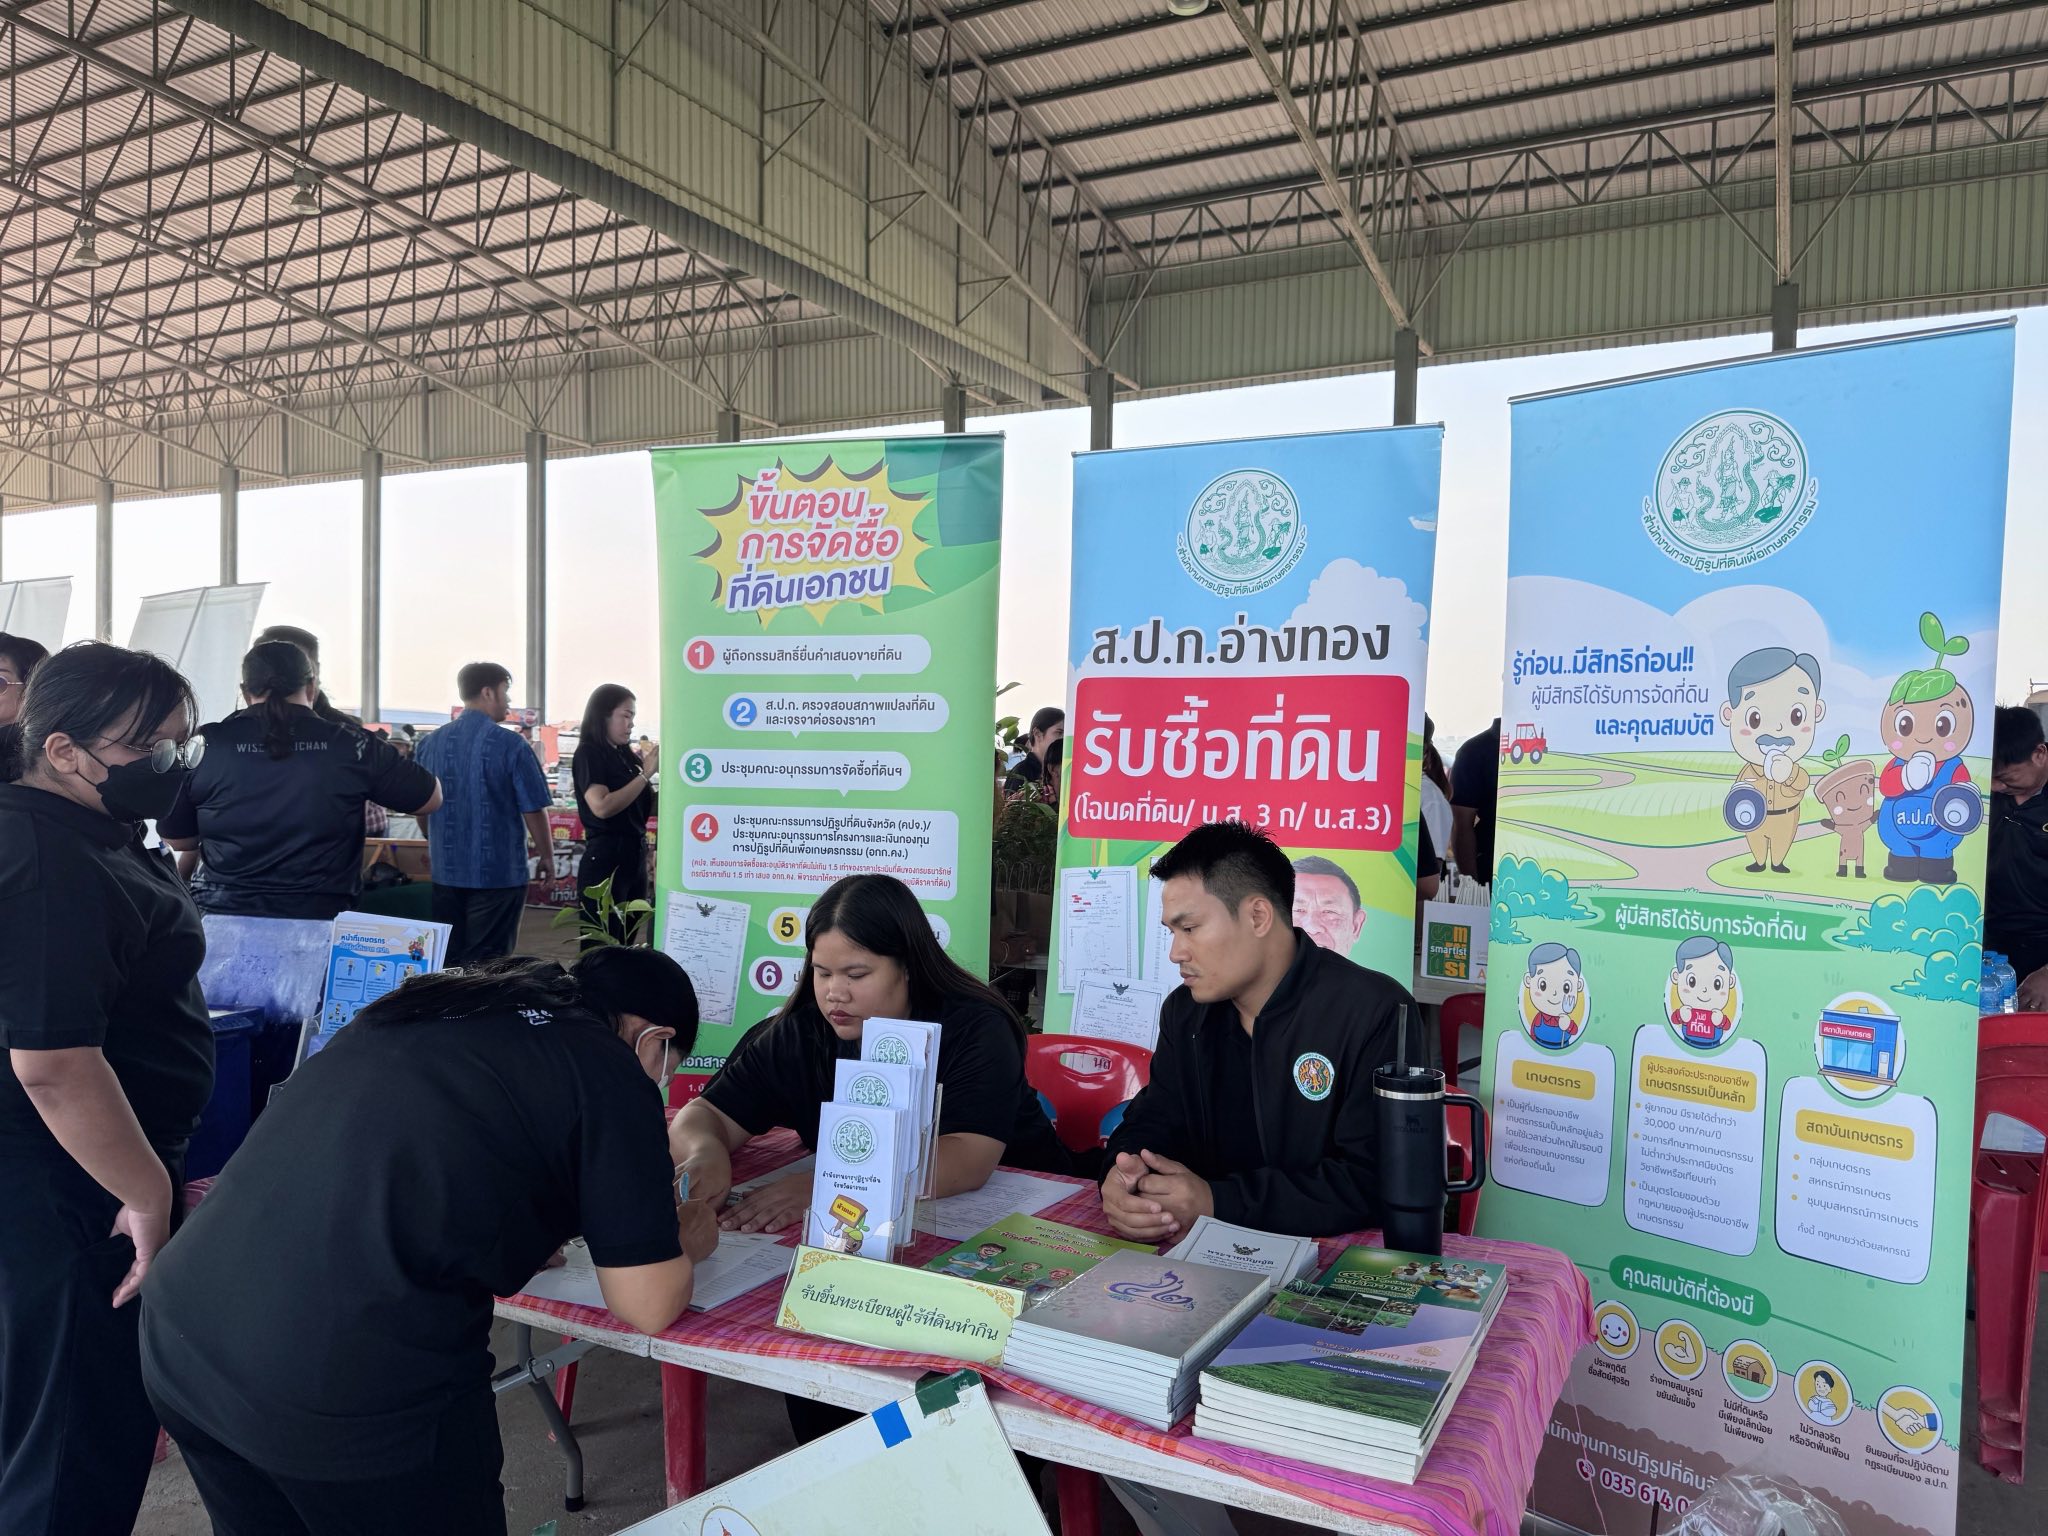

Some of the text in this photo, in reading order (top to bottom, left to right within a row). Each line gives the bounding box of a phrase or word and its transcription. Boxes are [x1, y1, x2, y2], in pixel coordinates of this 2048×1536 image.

[750, 472, 866, 521] ขั้นตอน
[740, 508, 899, 560] การจัดซื้อ
[728, 564, 889, 609] ที่ดินเอกชน
[1092, 614, 1391, 665] ส.ป.ก.อ่างทอง
[695, 645, 902, 666] 1 ผู้ถือกรรมสิทธิ์ยื่นคำเสนอขายที่ดิน
[1531, 678, 1709, 710] ผู้มีสิทธิได้รับการจัดที่ดิน
[735, 697, 935, 723] 2 ส.ป.ก. ตรวจสอบสภาพแปลงที่ดิน
[766, 712, 876, 727] และเจรจาต่อรองราคา
[1082, 694, 1380, 782] รับซื้อที่ดิน
[1595, 711, 1714, 744] และคุณสมบัติ
[691, 758, 902, 780] 3 ประชุมคณะอนุกรรมการจัดซื้อที่ดินฯ
[1074, 790, 1194, 827] (โฉนดที่ดิน/
[1256, 804, 1271, 827] 3
[1279, 802, 1307, 831] ก/
[1314, 804, 1392, 835] น.ส.3)
[697, 815, 932, 838] 4 ประชุมคณะกรรมการปฏิรูปที่ดินจังหวัด (คปจ.)/
[733, 829, 930, 845] ประชุมคณะอนุกรรมการโครงการและเงินกองทุน
[732, 842, 863, 857] การปฏิรูปที่ดินเพื่อเกษตรกรรม
[781, 917, 794, 937] 5
[1615, 904, 1807, 942] ผู้มีสิทธิได้รับการจัดที่ดิน
[762, 965, 776, 986] 6
[1691, 1019, 1711, 1034] ที่ดิน
[1526, 1071, 1581, 1089] เกษตรกร
[1647, 1062, 1750, 1089] ผู้ประสงค์จะประกอบอาชีพ
[1645, 1077, 1745, 1104] เกษตรกรรมเป็นหลัก
[1645, 1102, 1678, 1116] ผู้ยากจน
[1644, 1117, 1676, 1131] 30,000
[1806, 1120, 1904, 1149] สถาบันเกษตรกร
[1809, 1155, 1871, 1177] กลุ่มเกษตรกร
[1808, 1175, 1892, 1201] สหกรณ์การเกษตร
[1637, 1212, 1684, 1230] เกษตรกรรม
[1807, 1196, 1919, 1229] ชุมนุมสหกรณ์การเกษตร
[1623, 1266, 1754, 1317] คุณสมบัติที่ต้องมี
[801, 1284, 999, 1342] รับขึ้นทะเบียนผู้ไร้ที่ดินทำกิน
[1588, 1365, 1630, 1387] ซื่อสัตย์สุจริต
[1594, 1356, 1627, 1374] ประพฤติดี
[1650, 1373, 1703, 1398] ร่างกายสมบูรณ์
[1656, 1389, 1696, 1409] ขยันขันแข็ง
[1723, 1398, 1768, 1421] ไม่มีที่ดินหรือ
[1718, 1409, 1773, 1435] มีเพียงเล็กน้อย
[1724, 1422, 1764, 1445] ไม่เพียงพอ
[1800, 1422, 1841, 1444] ไม่วิกลจริต
[1602, 1470, 1634, 1496] 035
